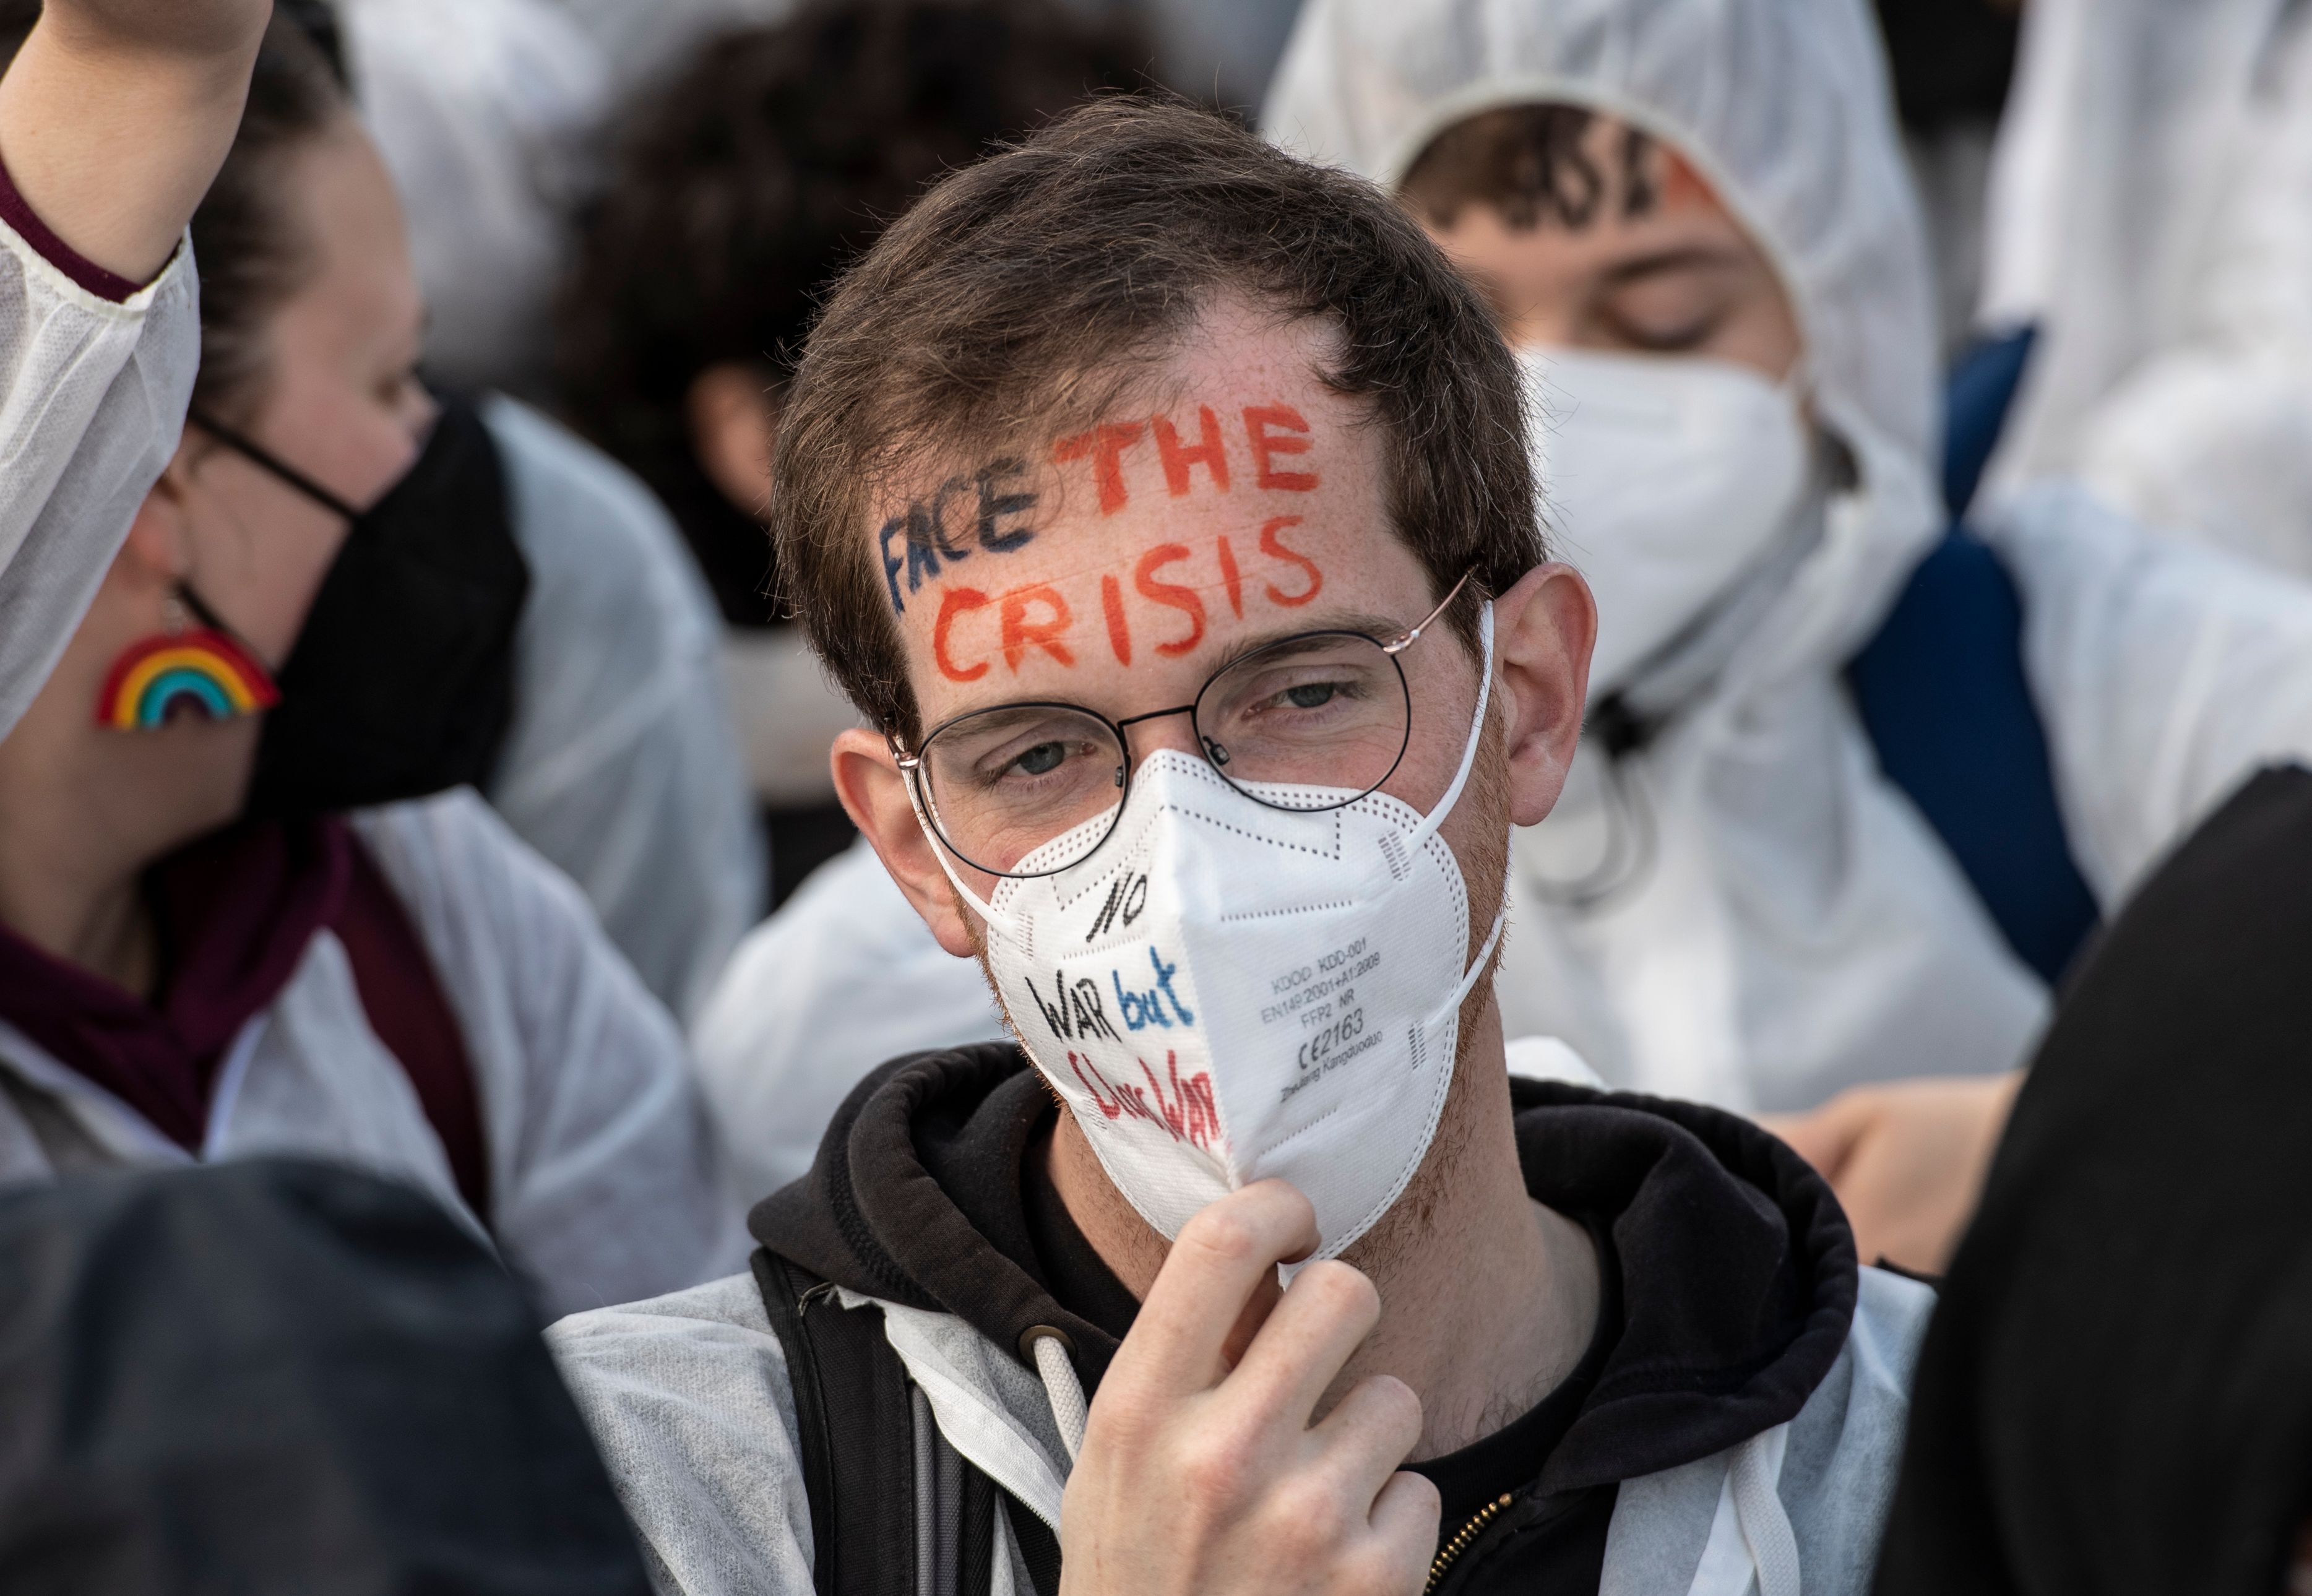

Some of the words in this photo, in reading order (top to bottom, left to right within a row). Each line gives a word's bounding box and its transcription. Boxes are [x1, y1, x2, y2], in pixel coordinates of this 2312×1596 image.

[878, 456, 1040, 614] FACE
[1054, 401, 1321, 515] THE
[933, 515, 1322, 683] CRISIS
[1086, 871, 1147, 943] NO
[1024, 969, 1123, 1044] WAR
[1112, 944, 1194, 1032] but
[1318, 936, 1367, 974] KDD-001
[1301, 1003, 1332, 1029] FFP2
[1339, 988, 1355, 1008] NR
